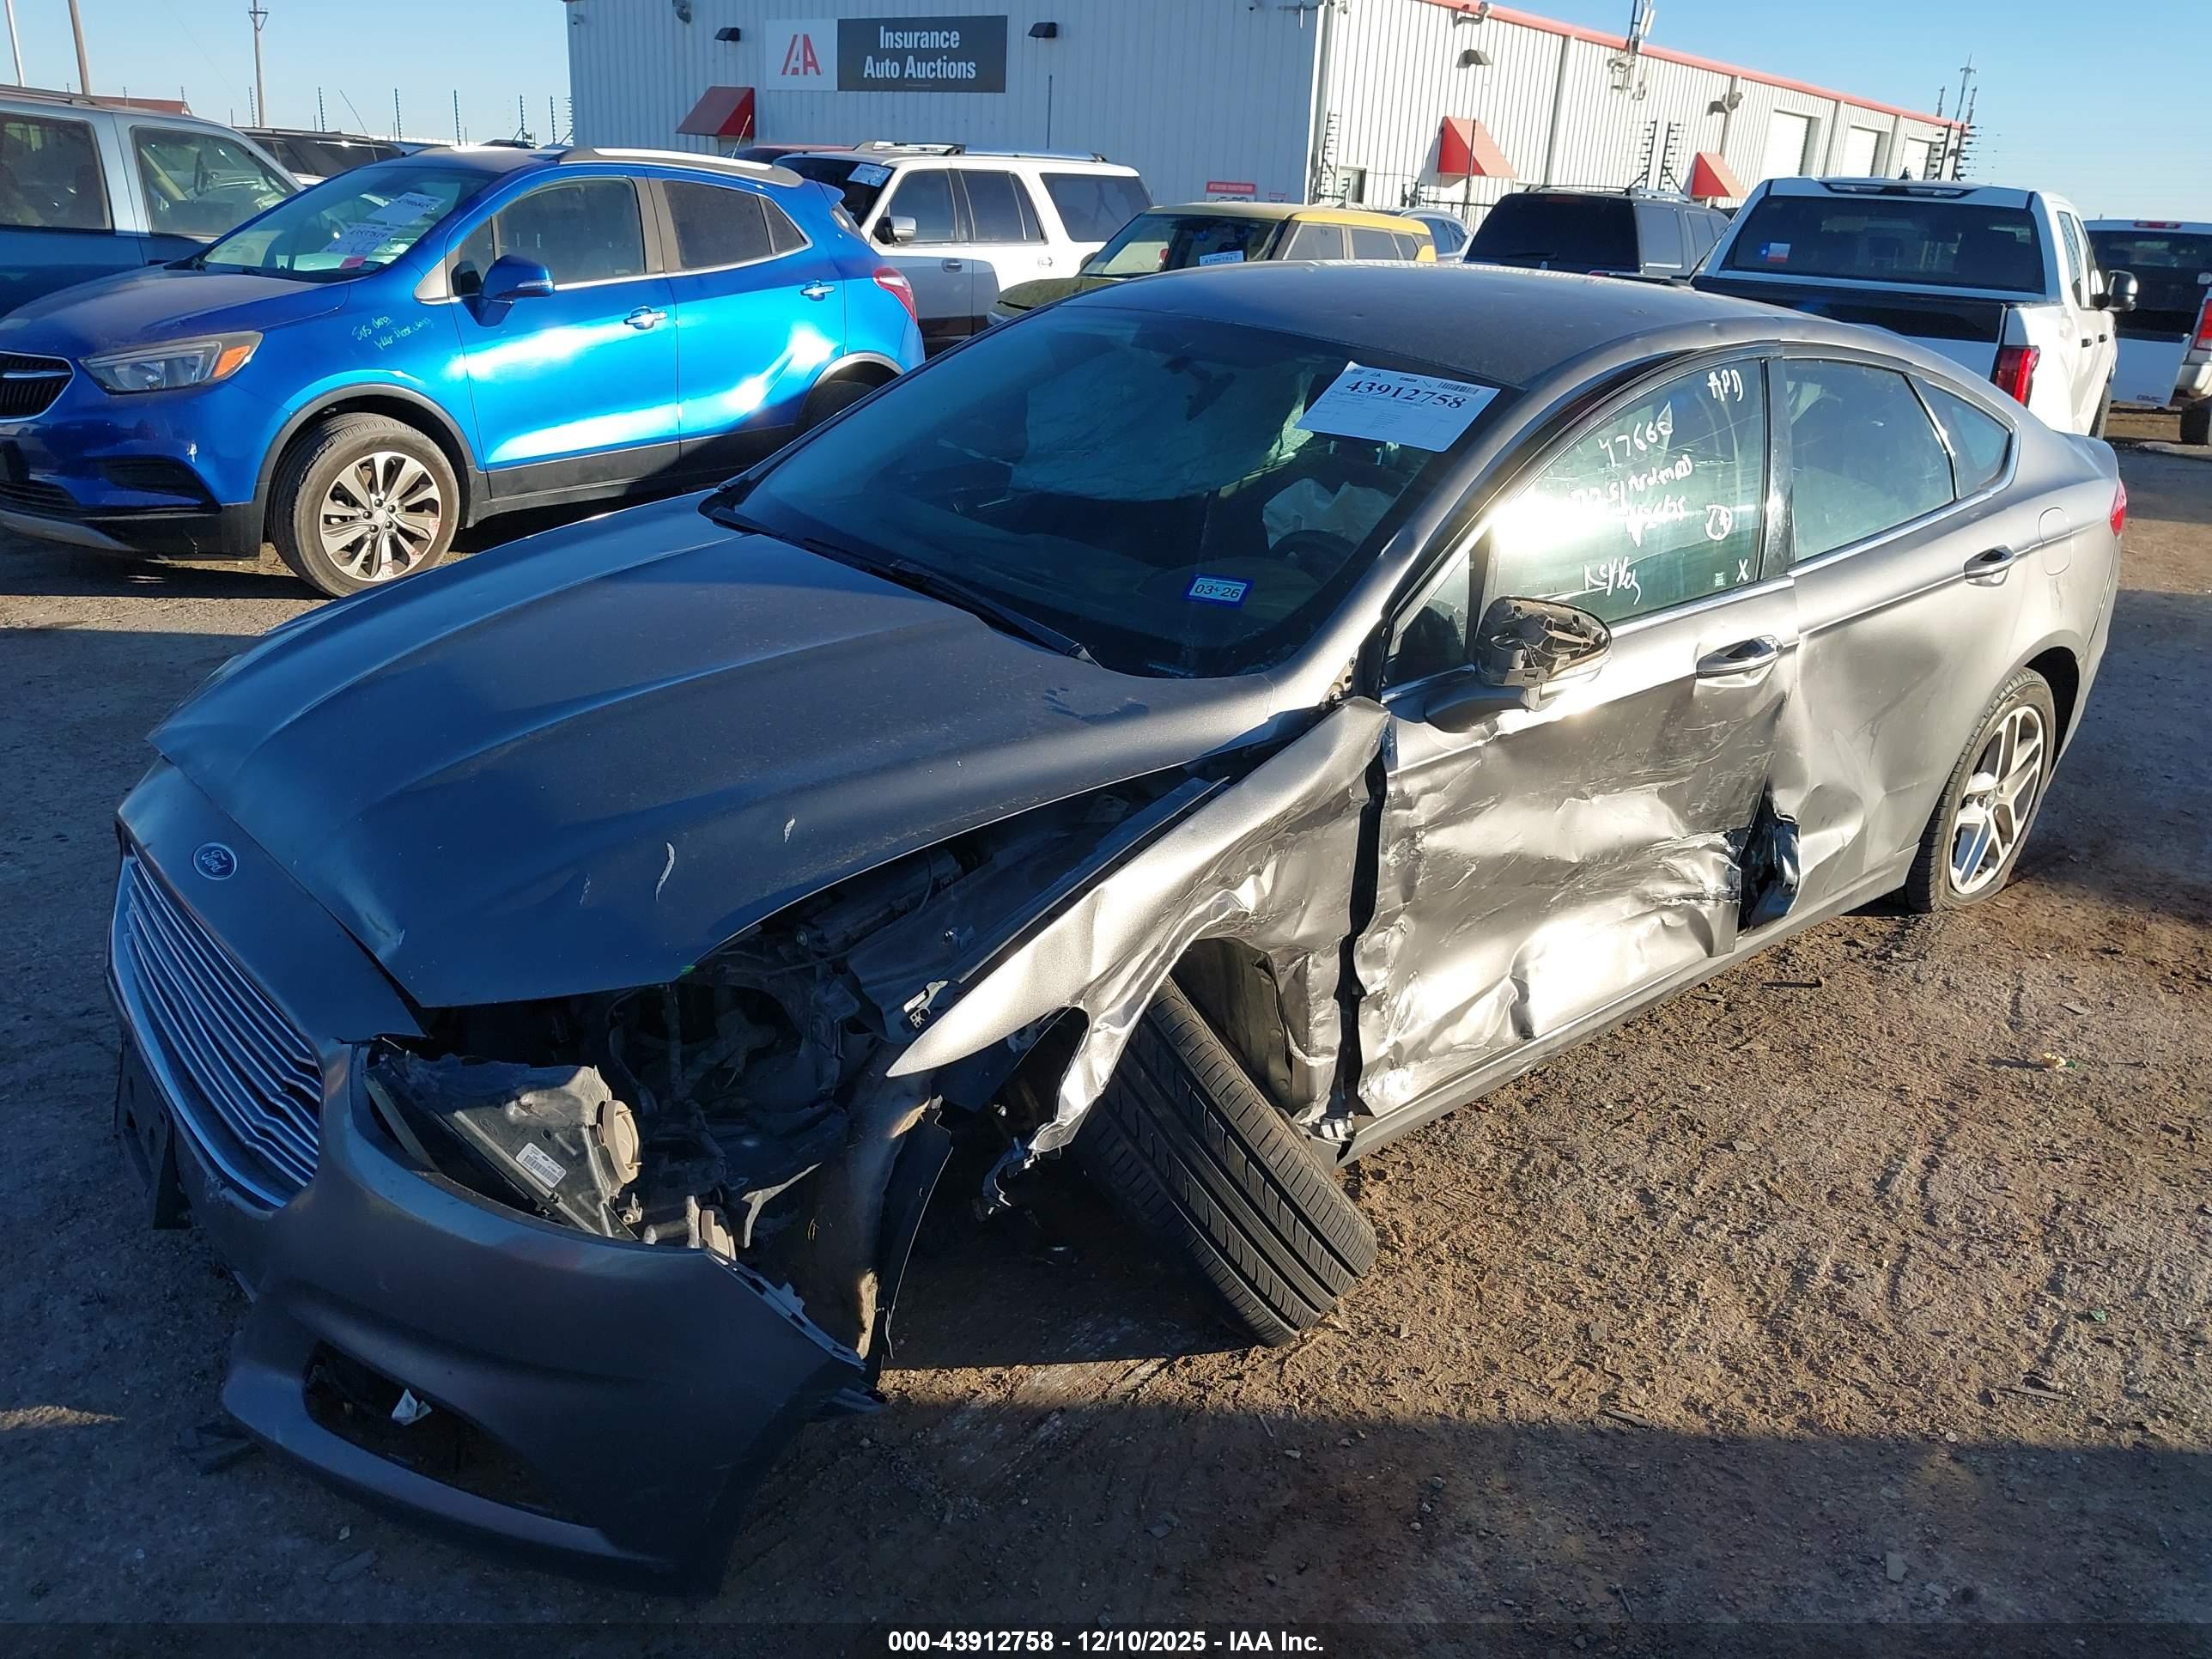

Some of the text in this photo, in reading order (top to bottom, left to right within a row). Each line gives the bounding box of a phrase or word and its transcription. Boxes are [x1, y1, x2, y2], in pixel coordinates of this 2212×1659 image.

[879, 26, 960, 50] Insurance
[863, 55, 976, 80] Auto Auctions
[1346, 380, 1467, 410] 43912758
